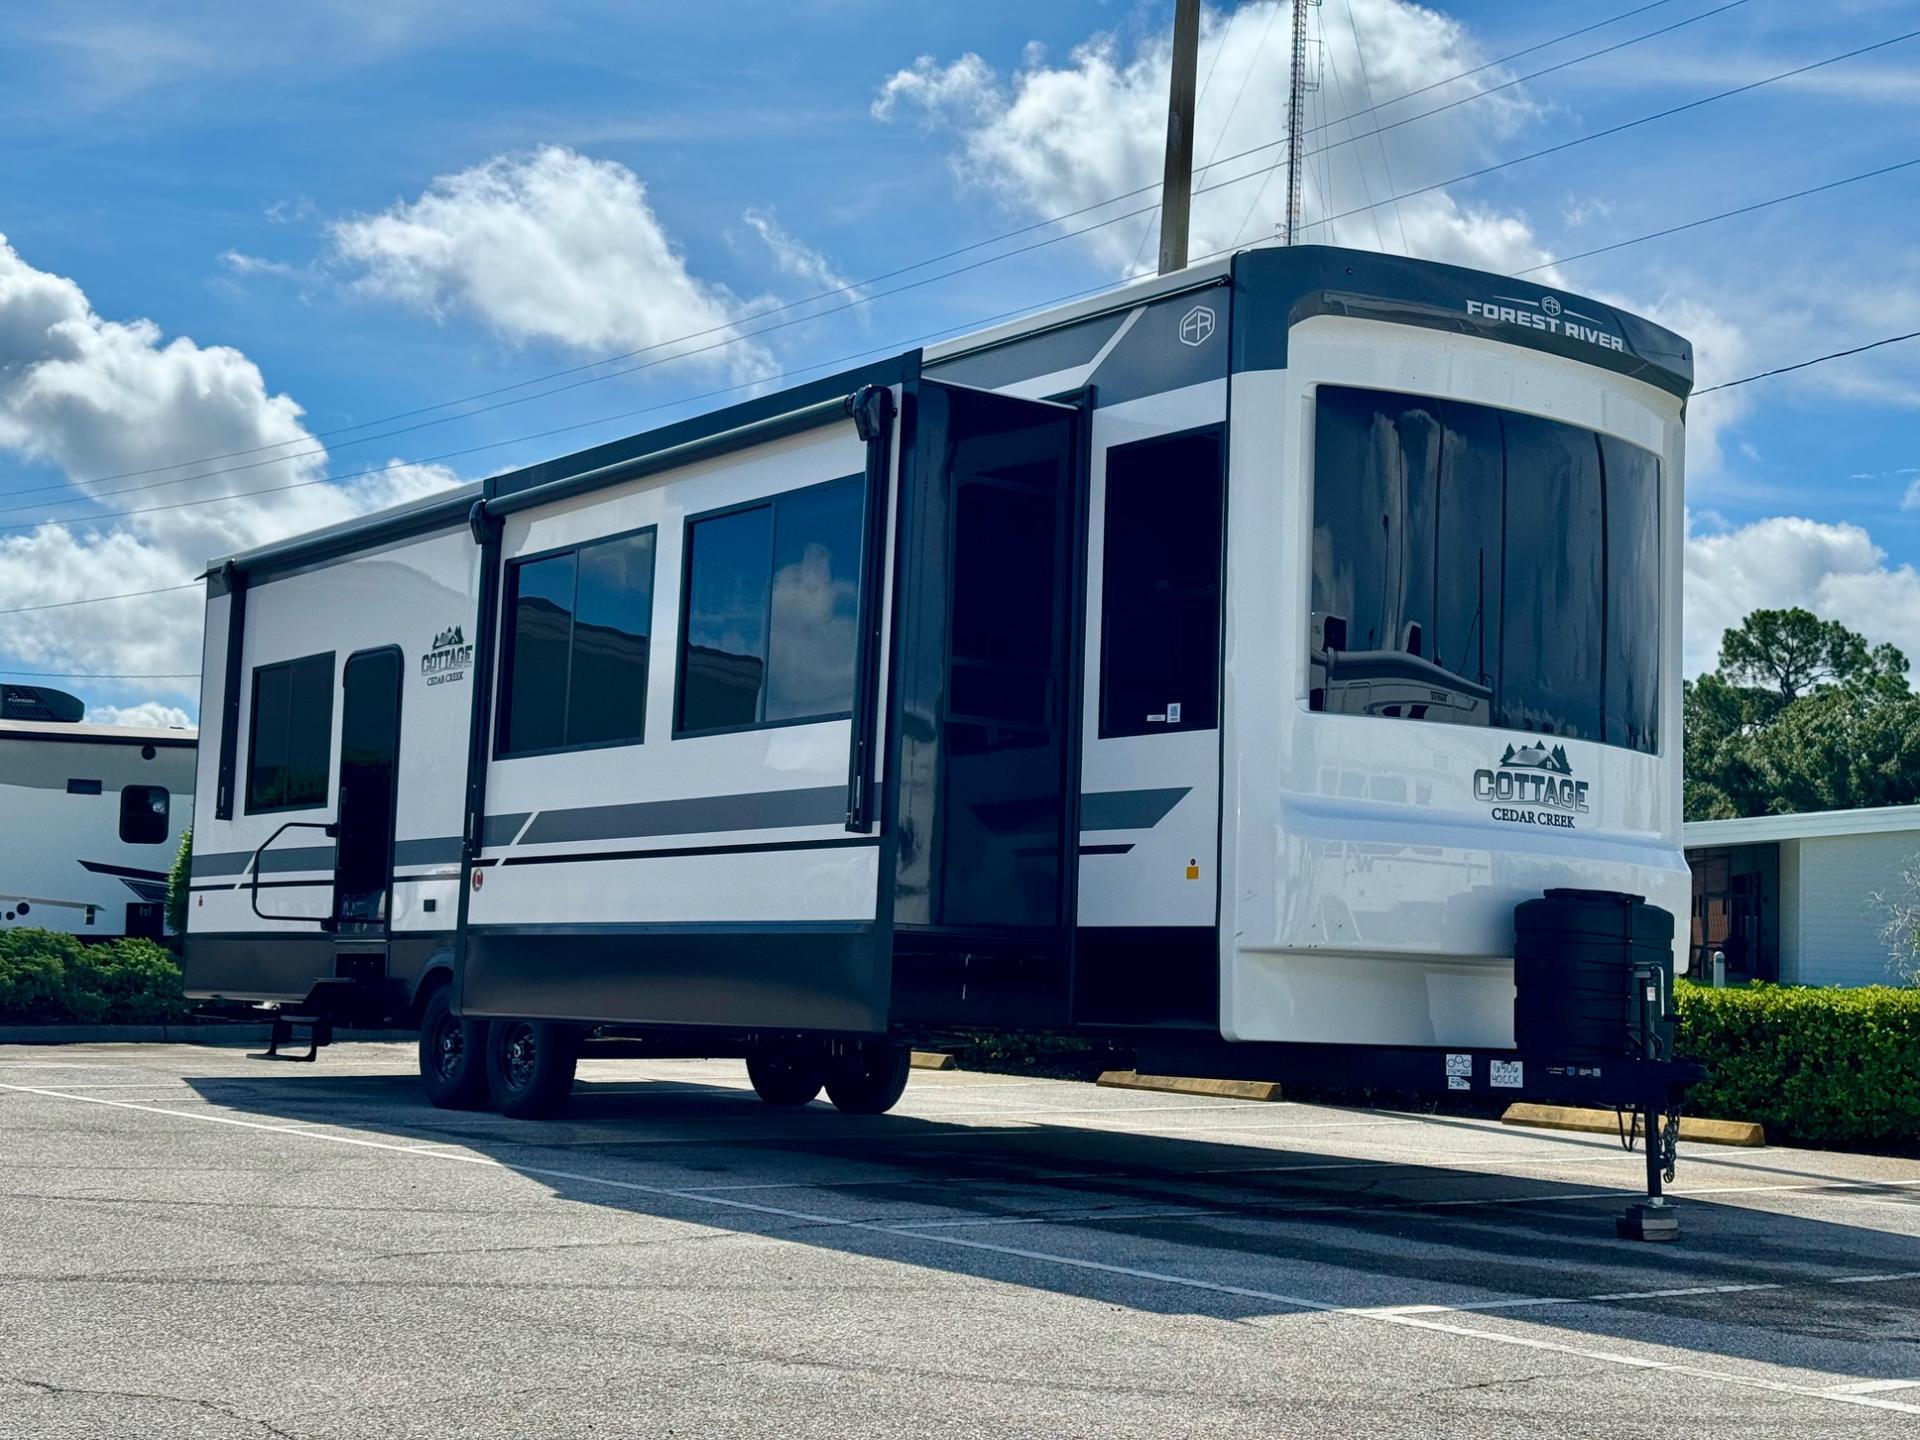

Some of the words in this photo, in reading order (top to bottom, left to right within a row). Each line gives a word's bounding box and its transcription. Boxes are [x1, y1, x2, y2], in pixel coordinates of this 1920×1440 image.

[1466, 299, 1560, 333] FOREST
[1564, 321, 1624, 353] RIVER
[421, 644, 473, 676] COTTAGE
[427, 675, 445, 687] CEDAR
[445, 671, 465, 683] CREEK
[1473, 768, 1590, 815] COTTAGE
[1491, 807, 1537, 825] CEDAR
[1537, 812, 1576, 829] CREEK
